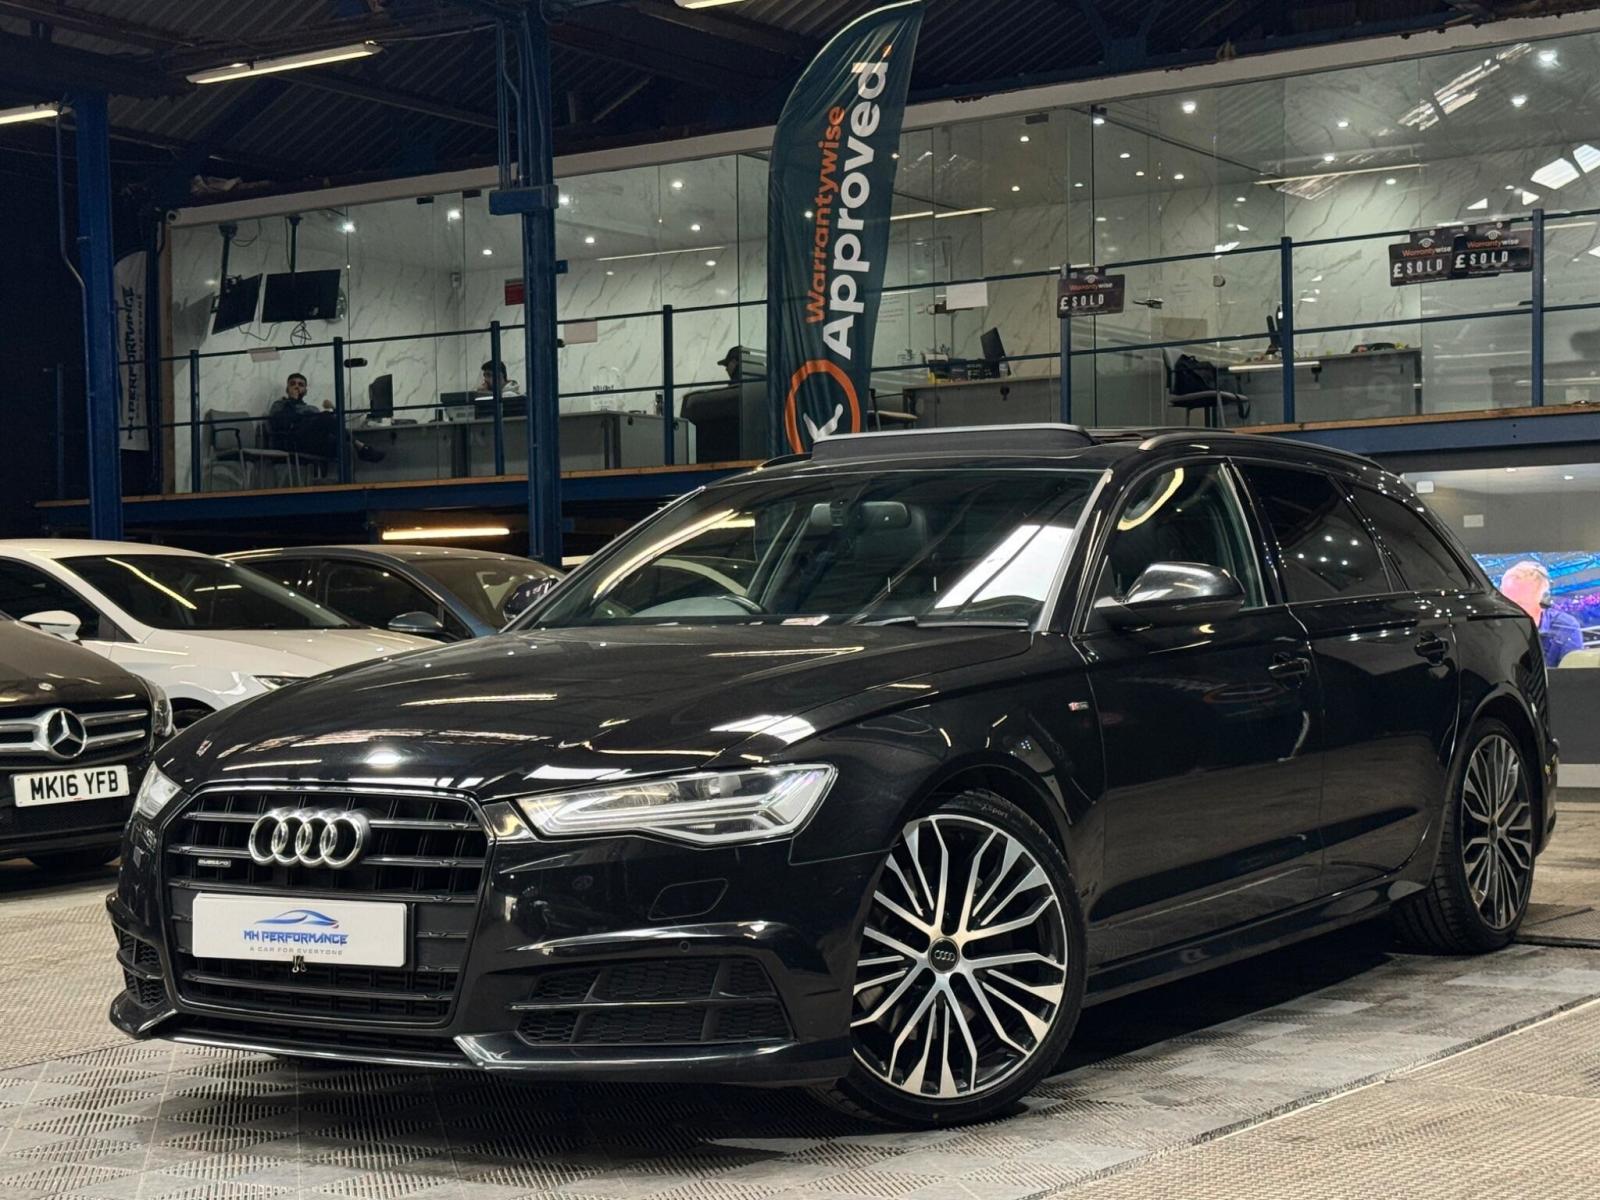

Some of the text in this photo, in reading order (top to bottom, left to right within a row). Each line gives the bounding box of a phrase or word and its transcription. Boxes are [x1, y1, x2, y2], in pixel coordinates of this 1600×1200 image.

[805, 105, 847, 325] Warrantywise
[30, 770, 119, 801] MK16 YFB
[243, 930, 349, 946] MH PERFORMANCE
